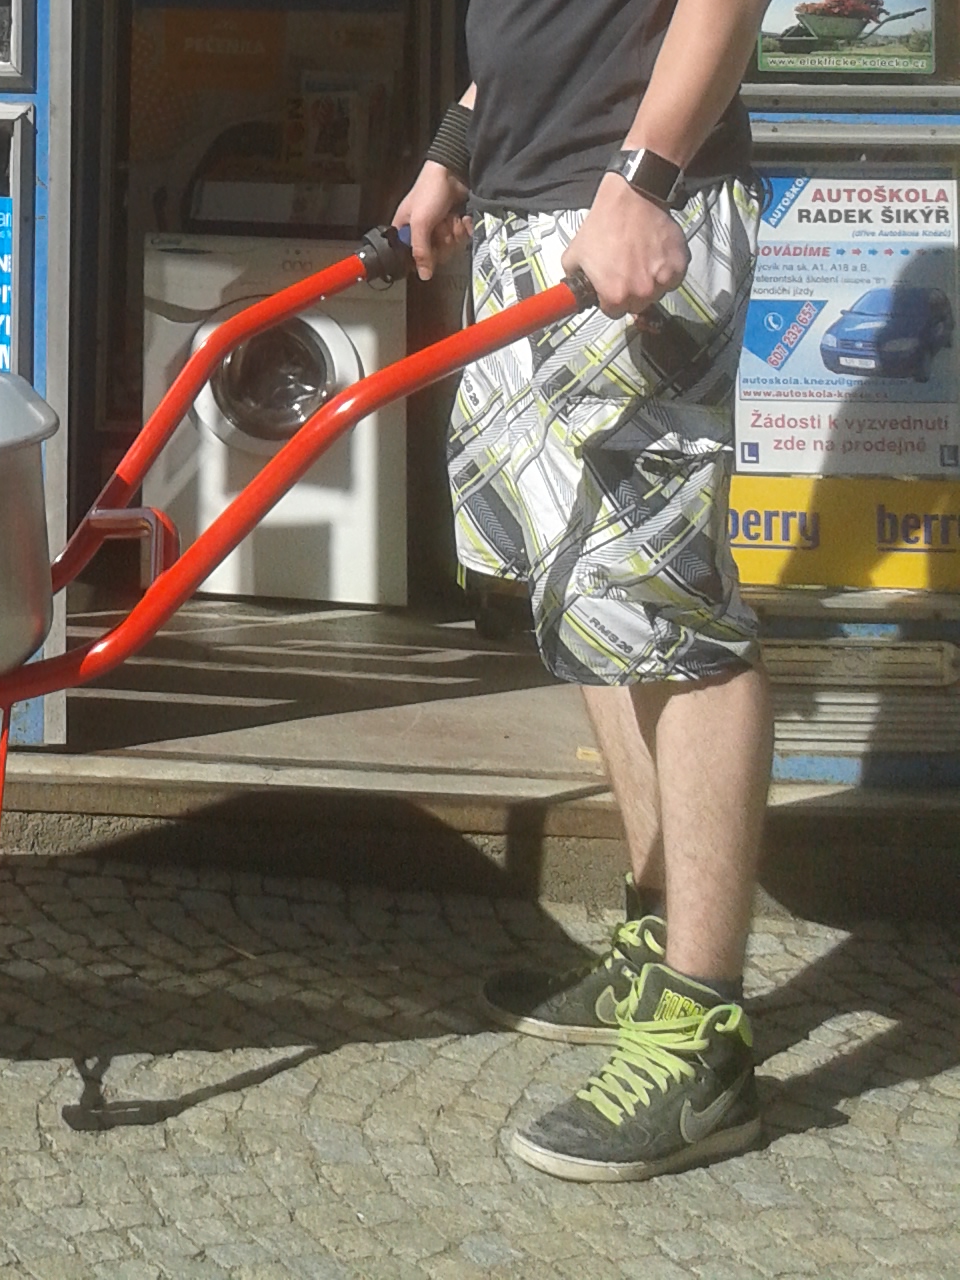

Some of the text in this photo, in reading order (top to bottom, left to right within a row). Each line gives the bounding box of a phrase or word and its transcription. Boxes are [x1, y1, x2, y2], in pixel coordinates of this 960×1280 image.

[767, 56, 928, 69] www.elektricke-kolecko.cz
[811, 185, 949, 204] AUTOŠKOLA
[797, 205, 950, 224] RADEK ŠIKÝŘ
[755, 245, 831, 257] OVÁDÍME
[766, 300, 819, 369] 607 232 657
[750, 409, 950, 434] Žádosti k vyzvednutí
[773, 435, 928, 456] zde na prodejně
[876, 503, 960, 546] berr
